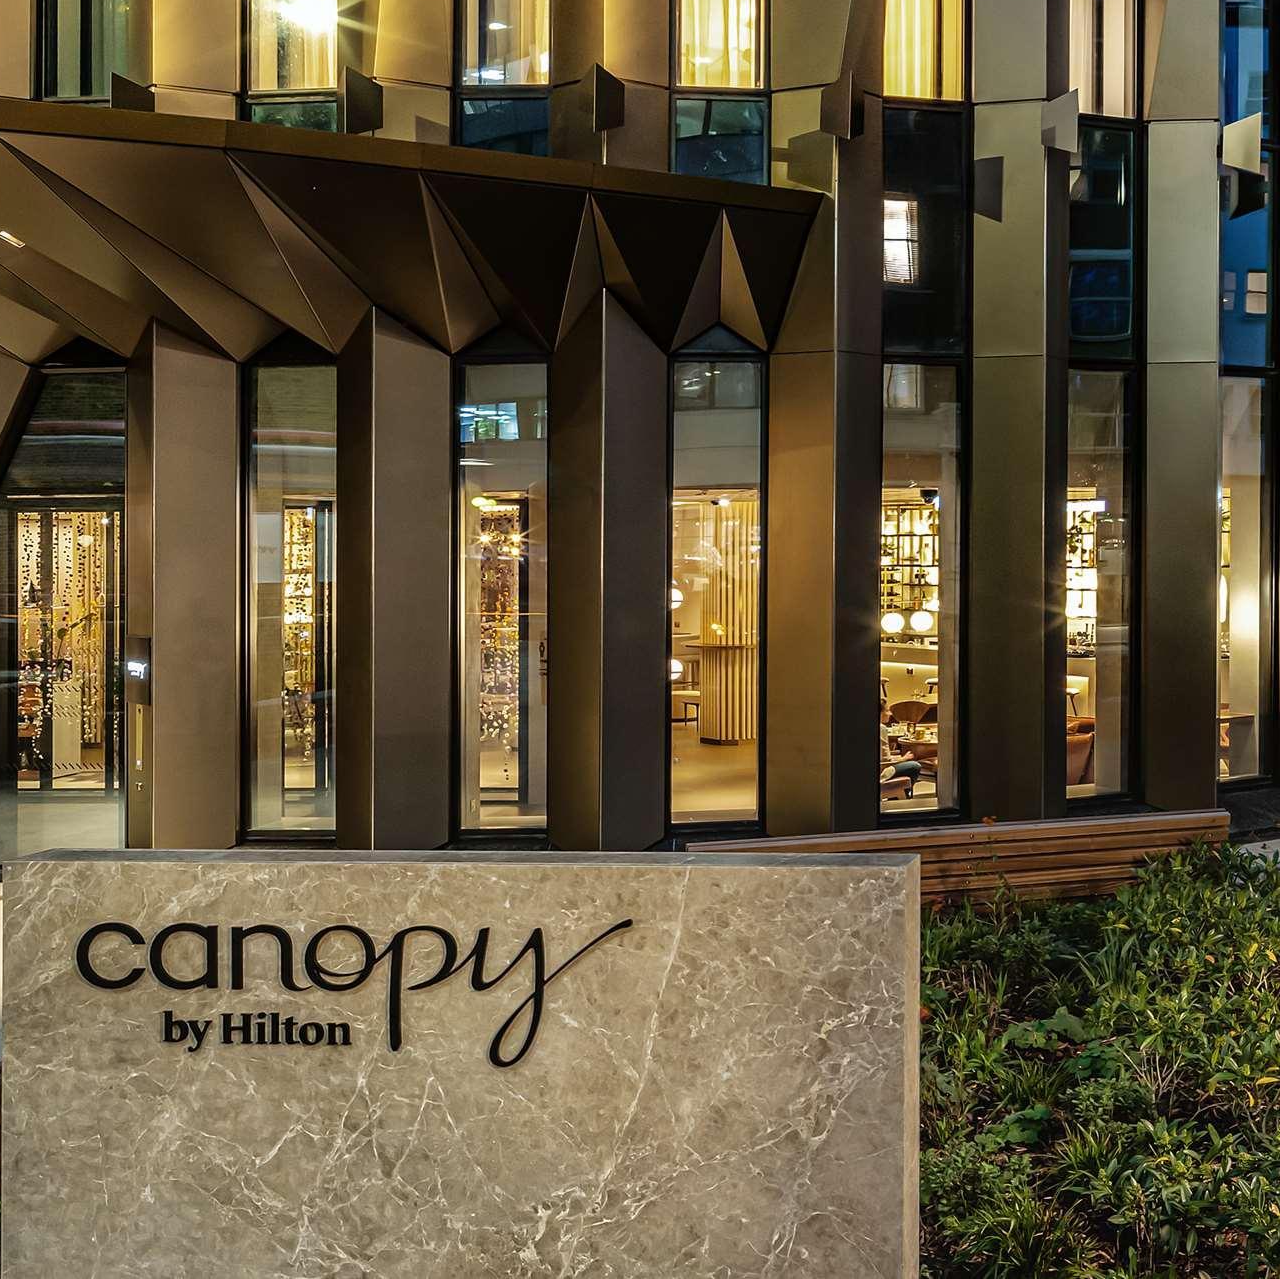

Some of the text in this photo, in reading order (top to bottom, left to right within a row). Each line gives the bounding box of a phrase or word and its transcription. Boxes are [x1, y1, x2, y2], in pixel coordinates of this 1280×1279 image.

[76, 918, 633, 1068] canopy
[163, 1010, 352, 1053] by Hilton
